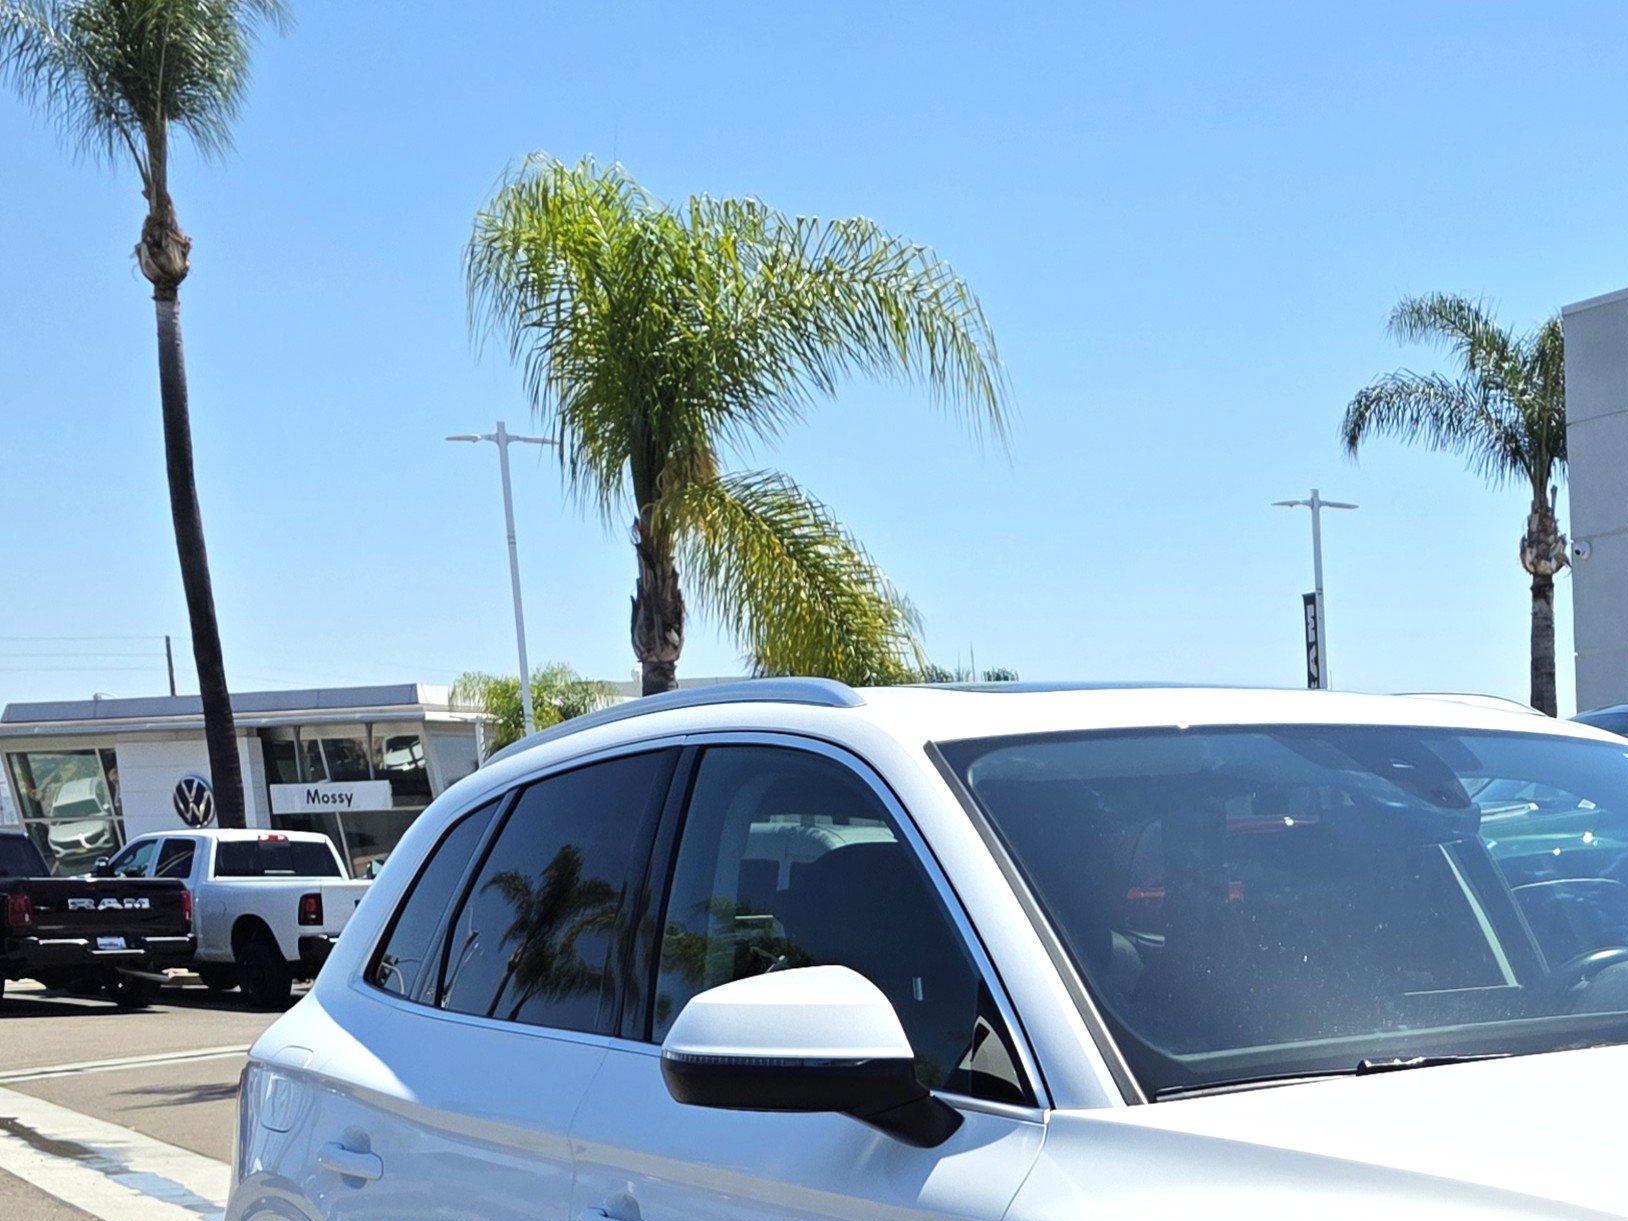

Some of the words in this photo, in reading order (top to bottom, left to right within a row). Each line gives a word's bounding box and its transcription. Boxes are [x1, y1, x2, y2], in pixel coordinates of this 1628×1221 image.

[1306, 604, 1318, 689] AM
[306, 788, 353, 808] Mossy
[67, 898, 150, 910] RAM
